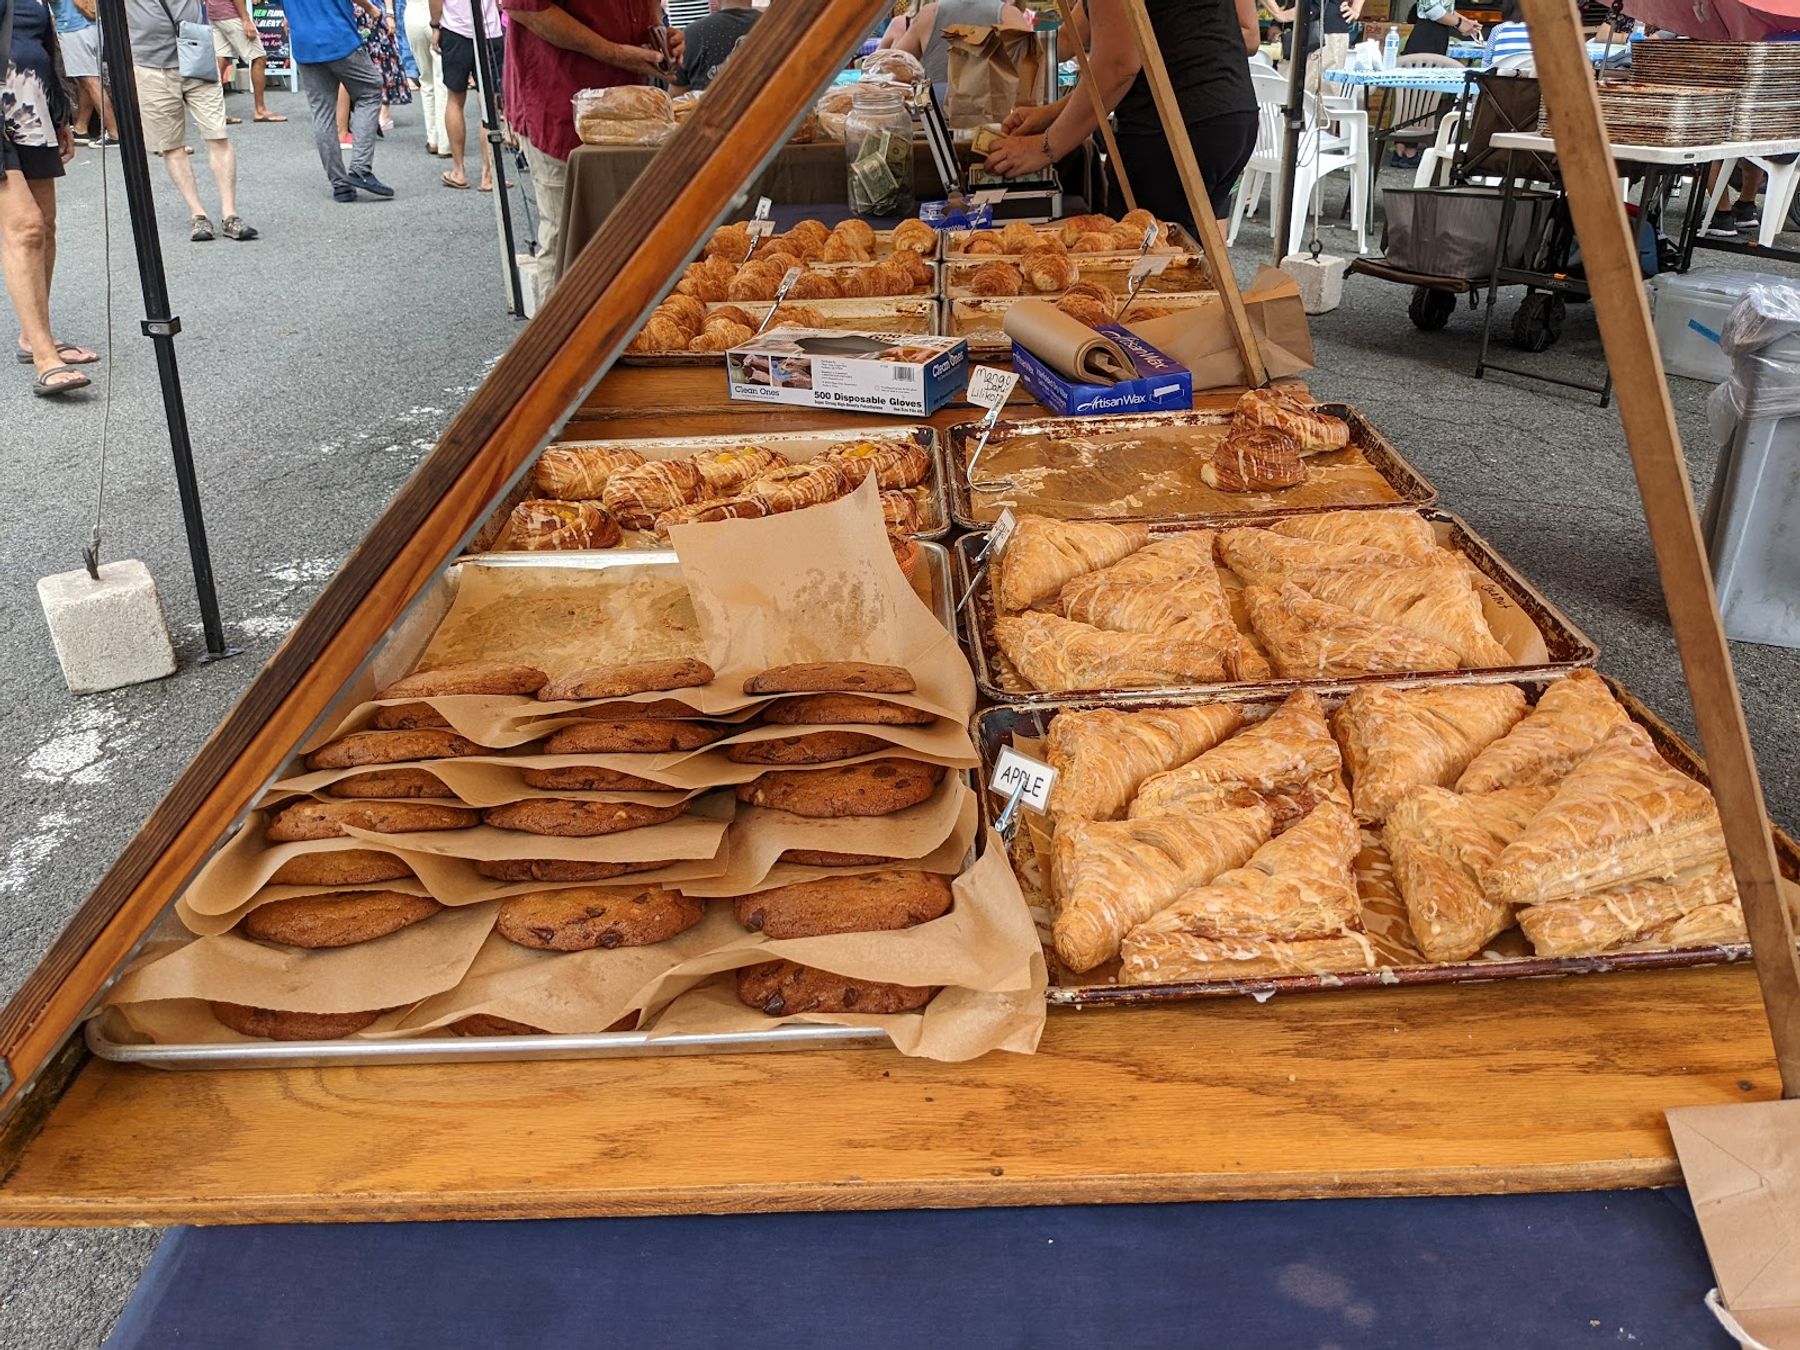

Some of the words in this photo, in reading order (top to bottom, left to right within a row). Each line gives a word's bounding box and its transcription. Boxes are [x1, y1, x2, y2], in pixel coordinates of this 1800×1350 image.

[932, 360, 951, 378] Clean
[734, 385, 759, 395] Clean
[759, 387, 781, 397] Ones
[814, 391, 831, 400] 500
[834, 392, 886, 405] Disposable
[889, 398, 922, 409] Gloves
[1077, 394, 1147, 412] ArtisanWax
[1000, 766, 1044, 798] APPLE
